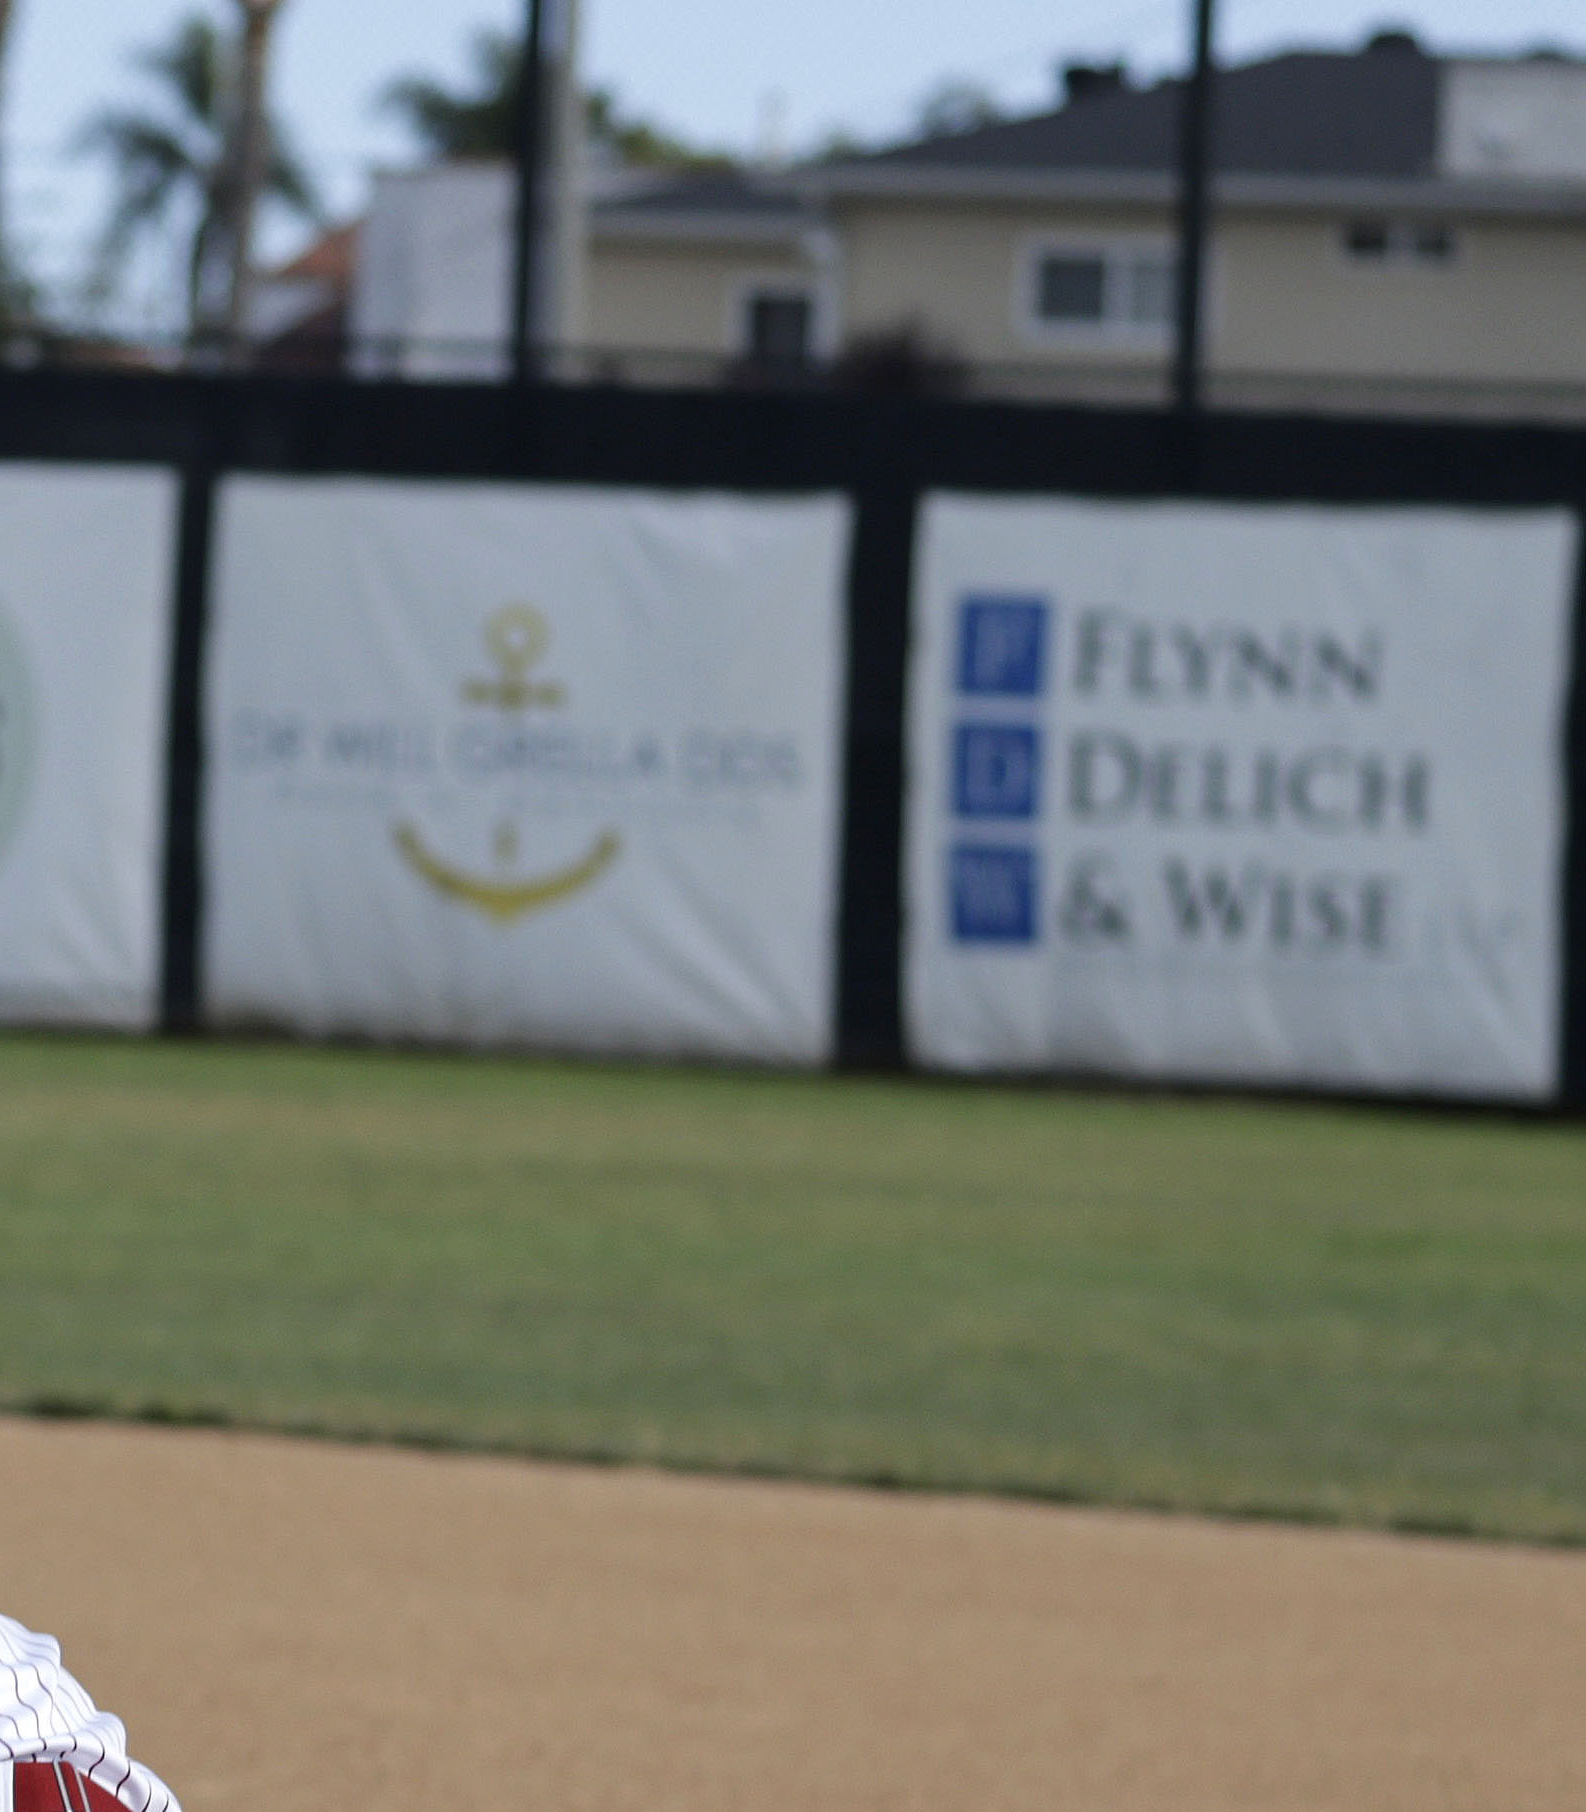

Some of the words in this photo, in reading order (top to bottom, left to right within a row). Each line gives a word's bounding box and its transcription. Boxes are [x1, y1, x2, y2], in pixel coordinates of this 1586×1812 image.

[1073, 604, 1384, 707] FLYNN
[1068, 727, 1433, 836] DELICH
[1059, 847, 1129, 951] &
[1163, 855, 1405, 962] WISE
